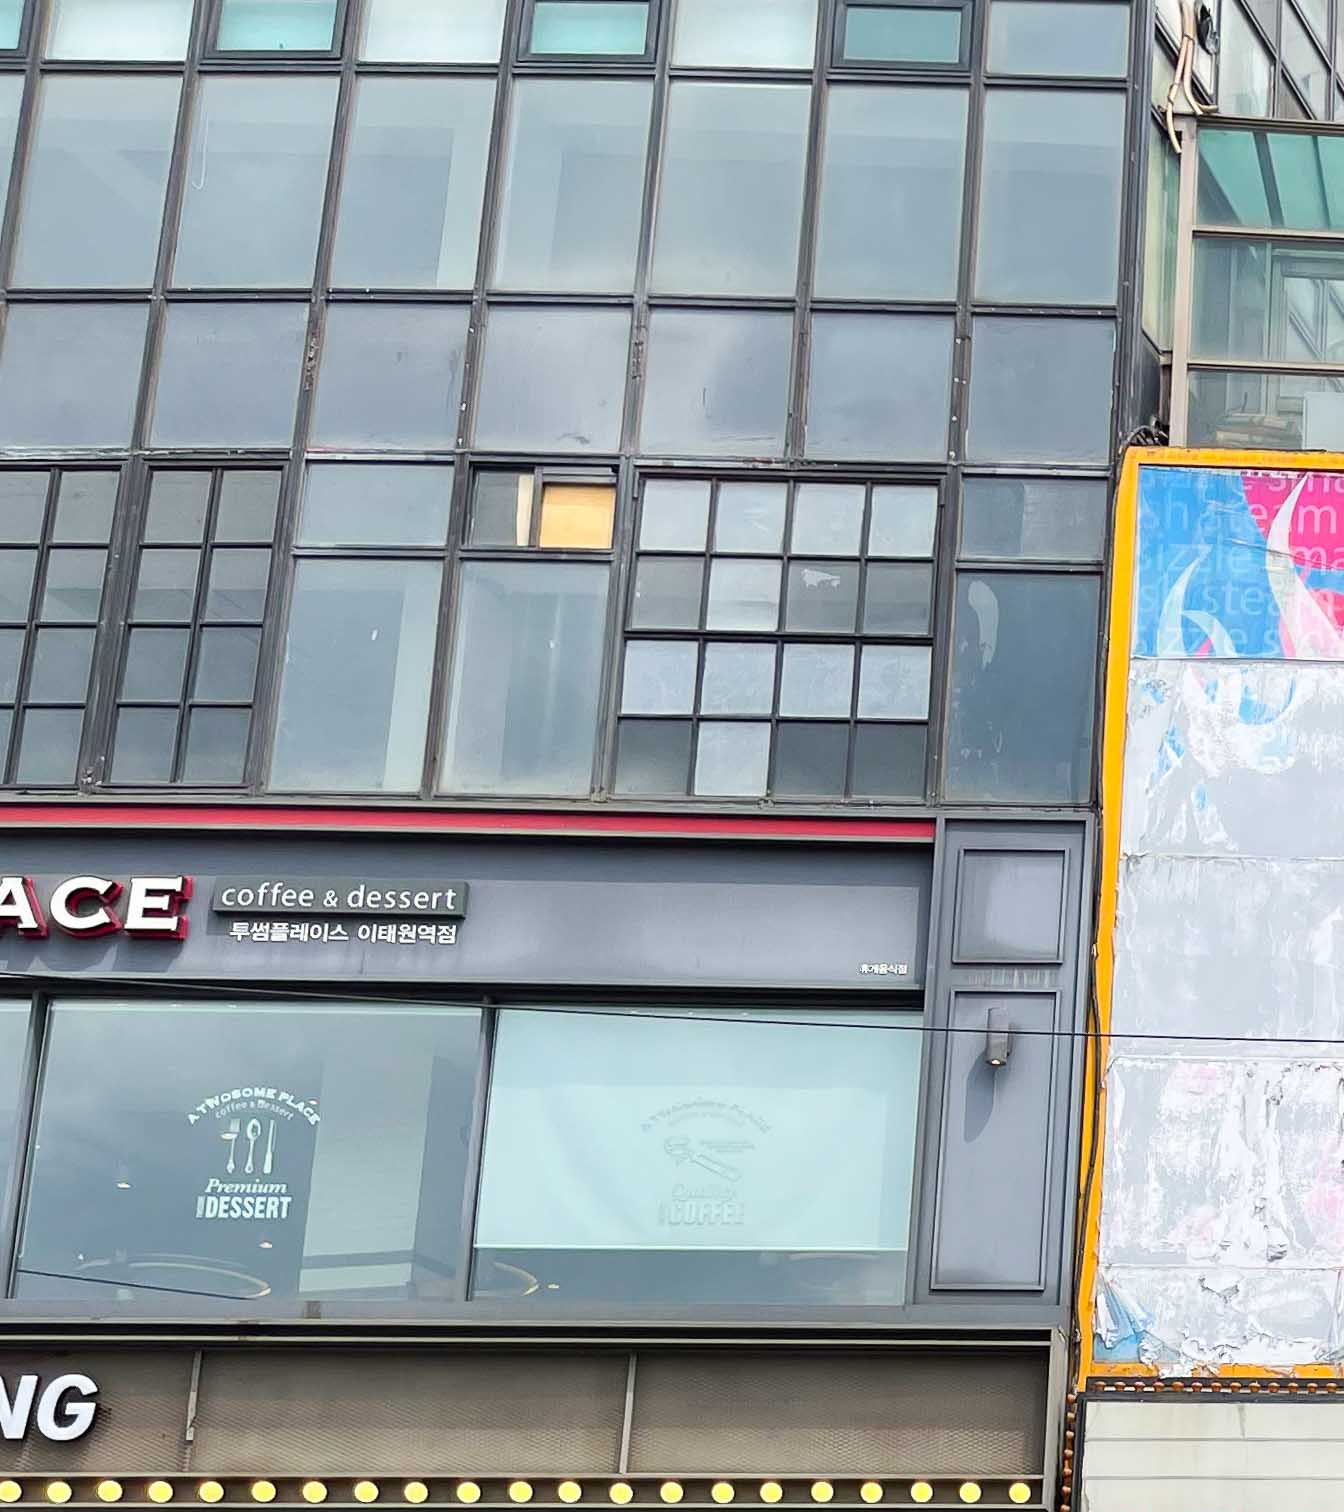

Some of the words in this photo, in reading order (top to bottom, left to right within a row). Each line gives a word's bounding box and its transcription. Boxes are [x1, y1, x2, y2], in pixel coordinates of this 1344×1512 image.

[222, 882, 314, 909] coffee
[323, 890, 339, 909] &
[346, 883, 457, 911] dessert
[229, 922, 349, 942] 투썸플레이스
[358, 924, 457, 944] 이태원역점
[196, 1087, 277, 1114] TWOSOME
[278, 1091, 321, 1126] PLACE
[205, 1177, 288, 1194] Premium
[205, 1195, 293, 1219] DESSERT
[0, 1373, 99, 1441] NG
